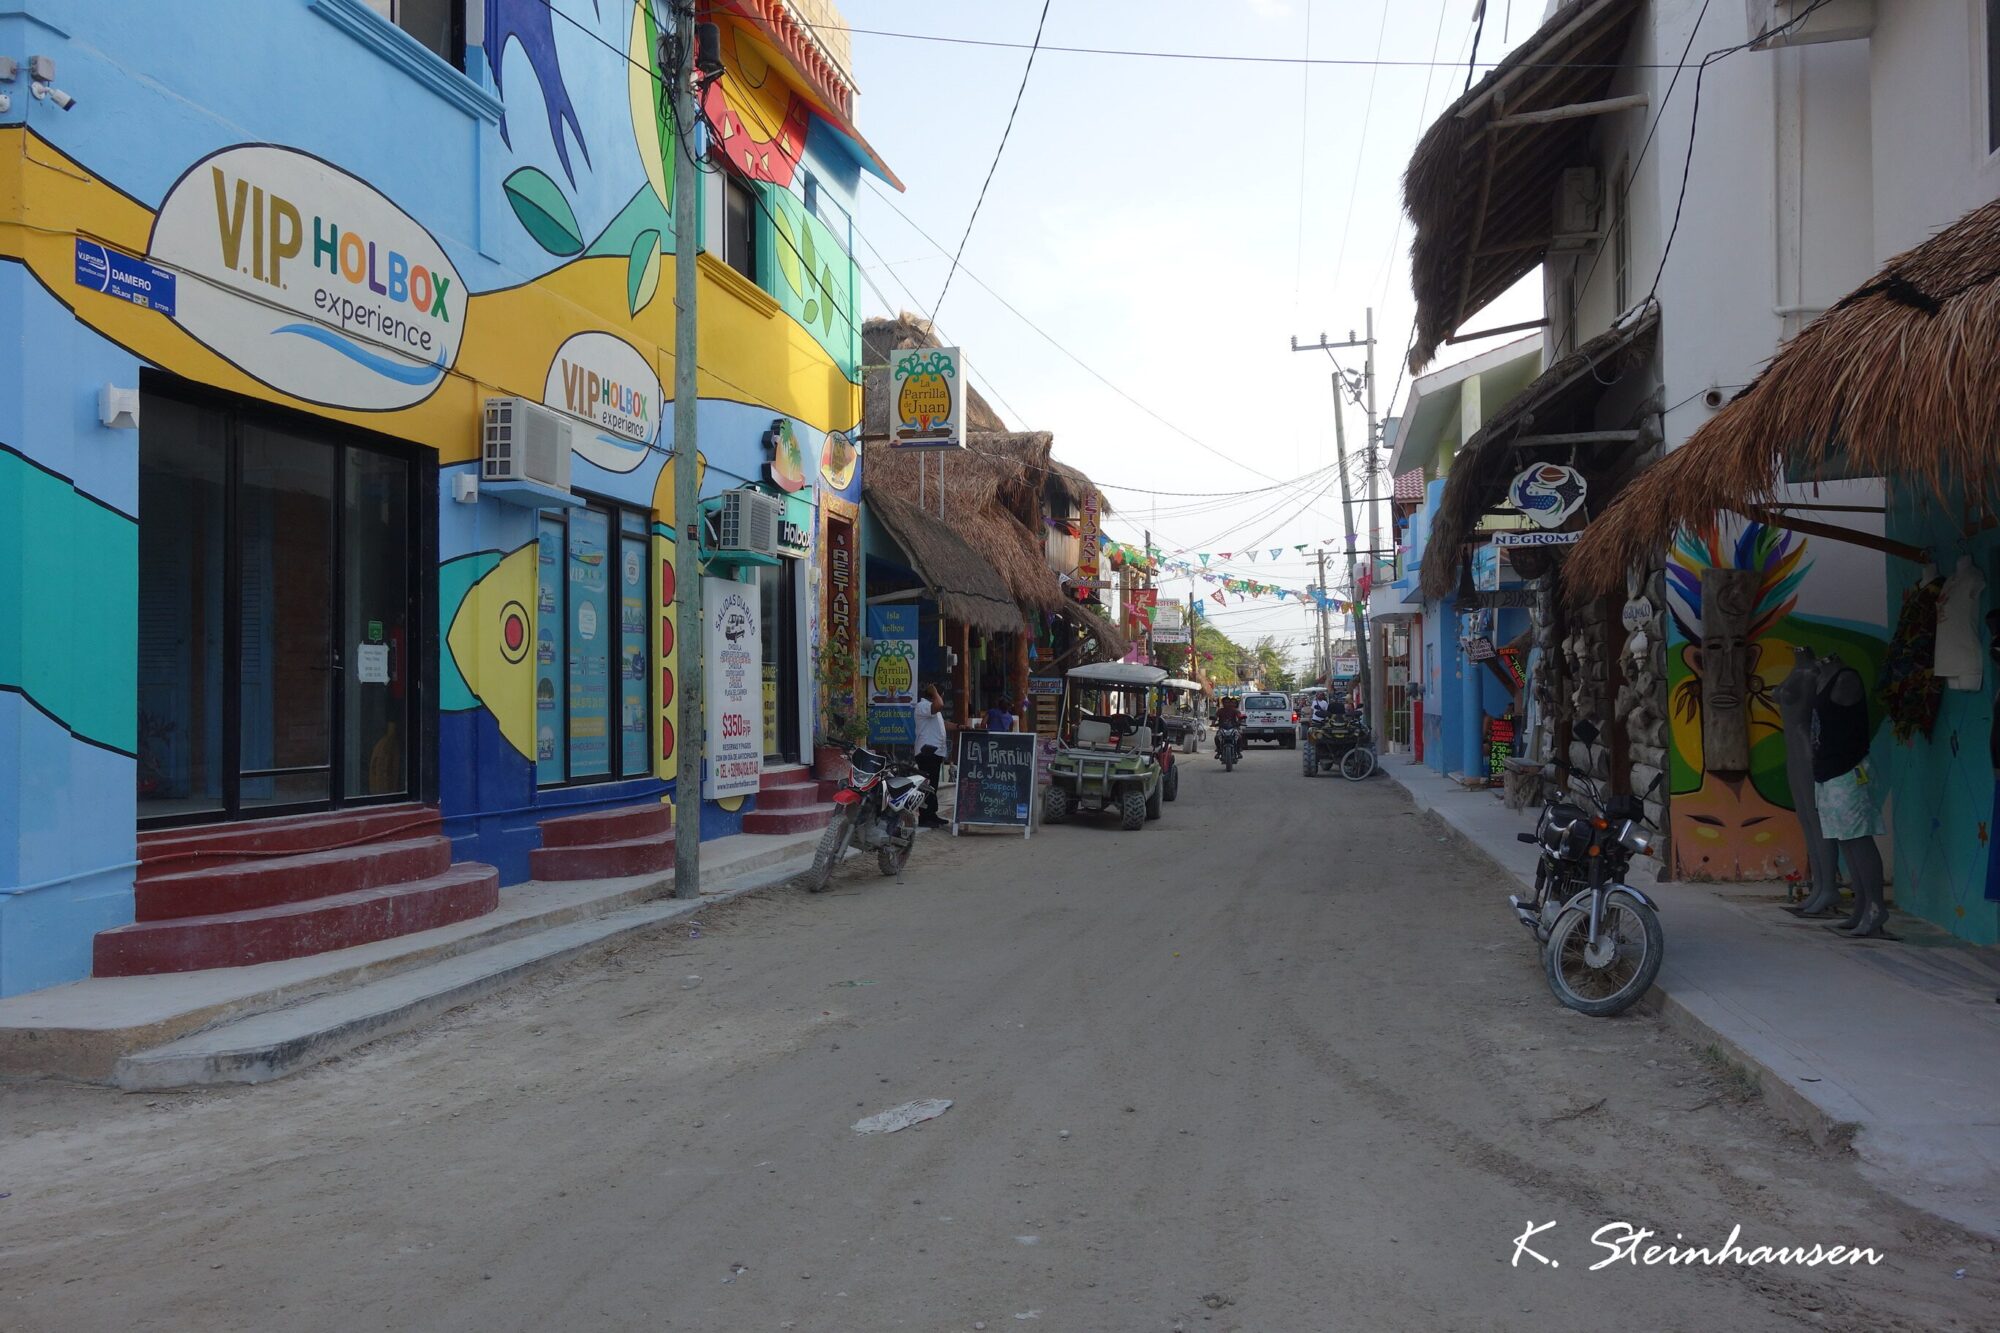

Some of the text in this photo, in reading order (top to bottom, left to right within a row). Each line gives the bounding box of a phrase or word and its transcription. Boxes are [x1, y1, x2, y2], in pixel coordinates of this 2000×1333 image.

[111, 269, 152, 291] DAMERO
[314, 216, 451, 323] HOLBOX
[314, 288, 432, 351] experience
[602, 377, 648, 422] HOLBOX
[904, 388, 946, 399] Parrilla
[909, 399, 945, 413] Juan
[602, 411, 644, 438] experience
[784, 522, 812, 547] Holbox
[715, 594, 755, 636] SALIDAS DIARIAS
[887, 611, 900, 620] Isla
[877, 665, 908, 675] Parrilla
[880, 674, 908, 686] Juan
[722, 712, 742, 739] $350
[967, 740, 982, 764] LA
[967, 764, 984, 779] de
